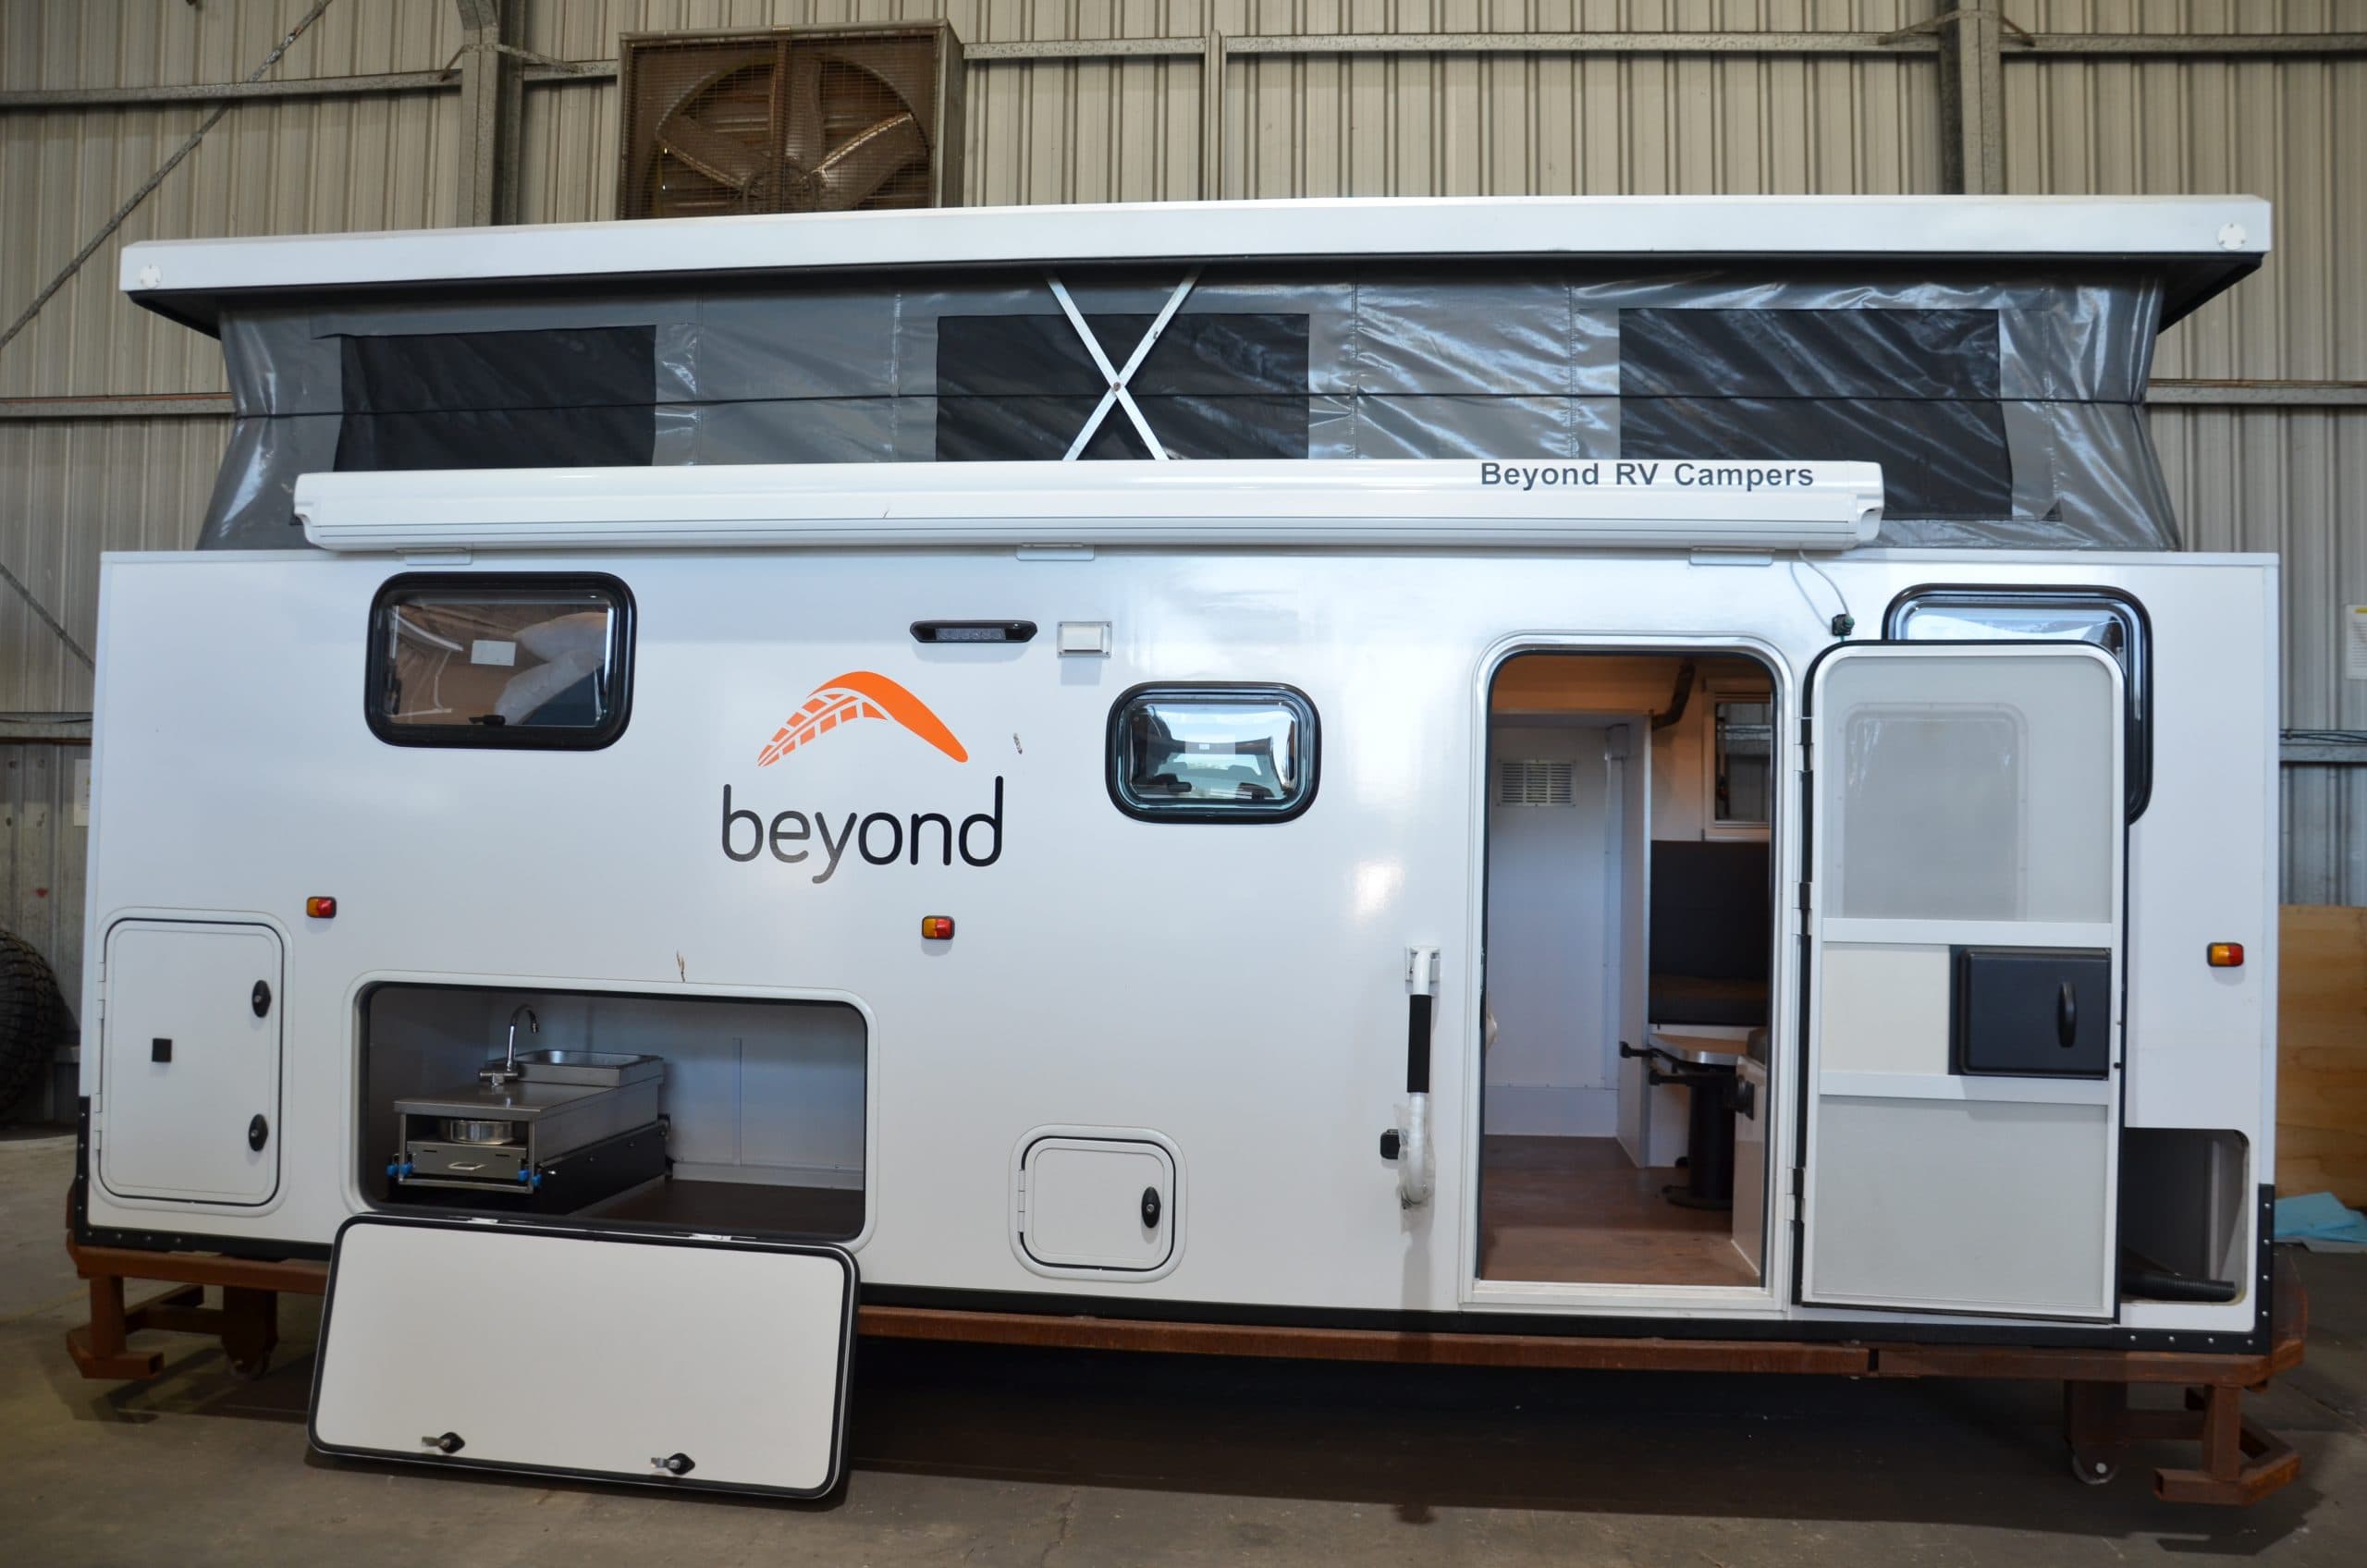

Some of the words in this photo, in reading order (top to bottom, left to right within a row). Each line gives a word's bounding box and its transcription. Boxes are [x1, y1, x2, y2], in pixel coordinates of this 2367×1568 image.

[1480, 462, 1599, 492] Beyond
[1615, 462, 1659, 485] RV
[1674, 463, 1814, 492] Campers
[721, 775, 1004, 885] beyond
